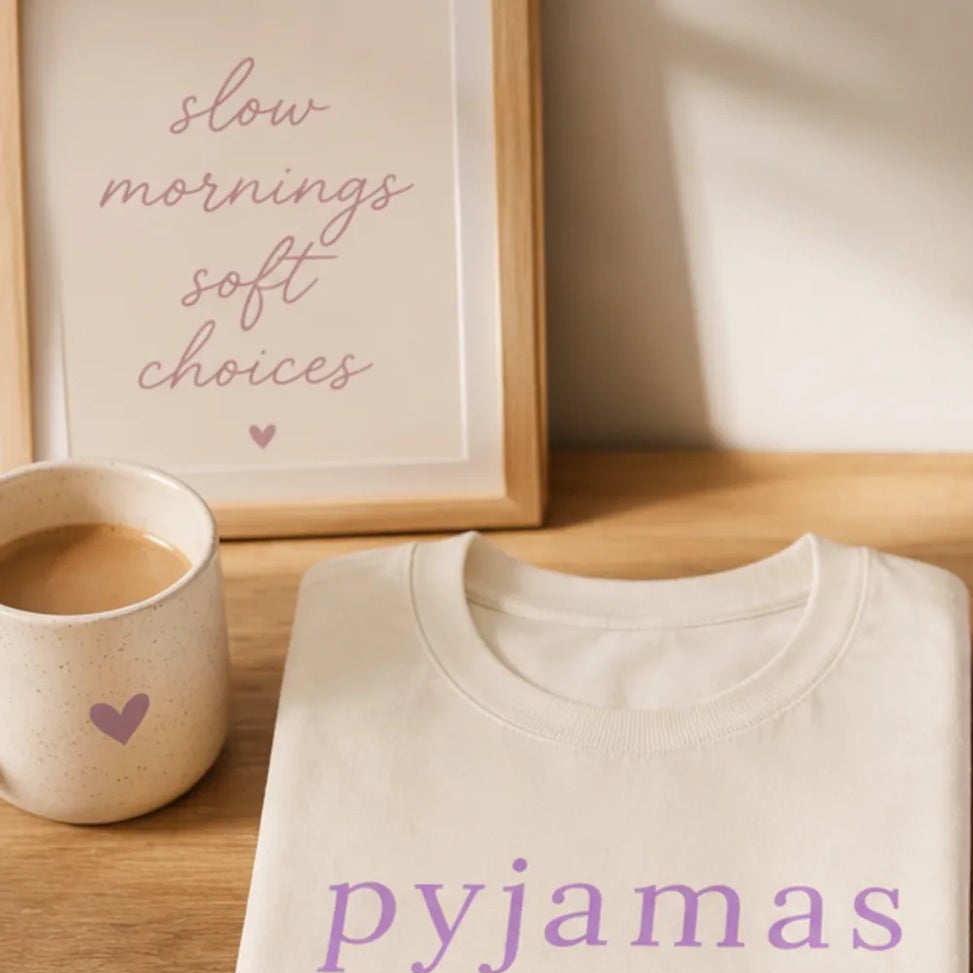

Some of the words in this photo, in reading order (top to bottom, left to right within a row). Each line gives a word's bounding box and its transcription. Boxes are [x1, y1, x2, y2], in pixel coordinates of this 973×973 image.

[169, 56, 331, 136] slow
[99, 167, 415, 248] mornings
[180, 235, 338, 332] soft
[137, 319, 374, 391] choices
